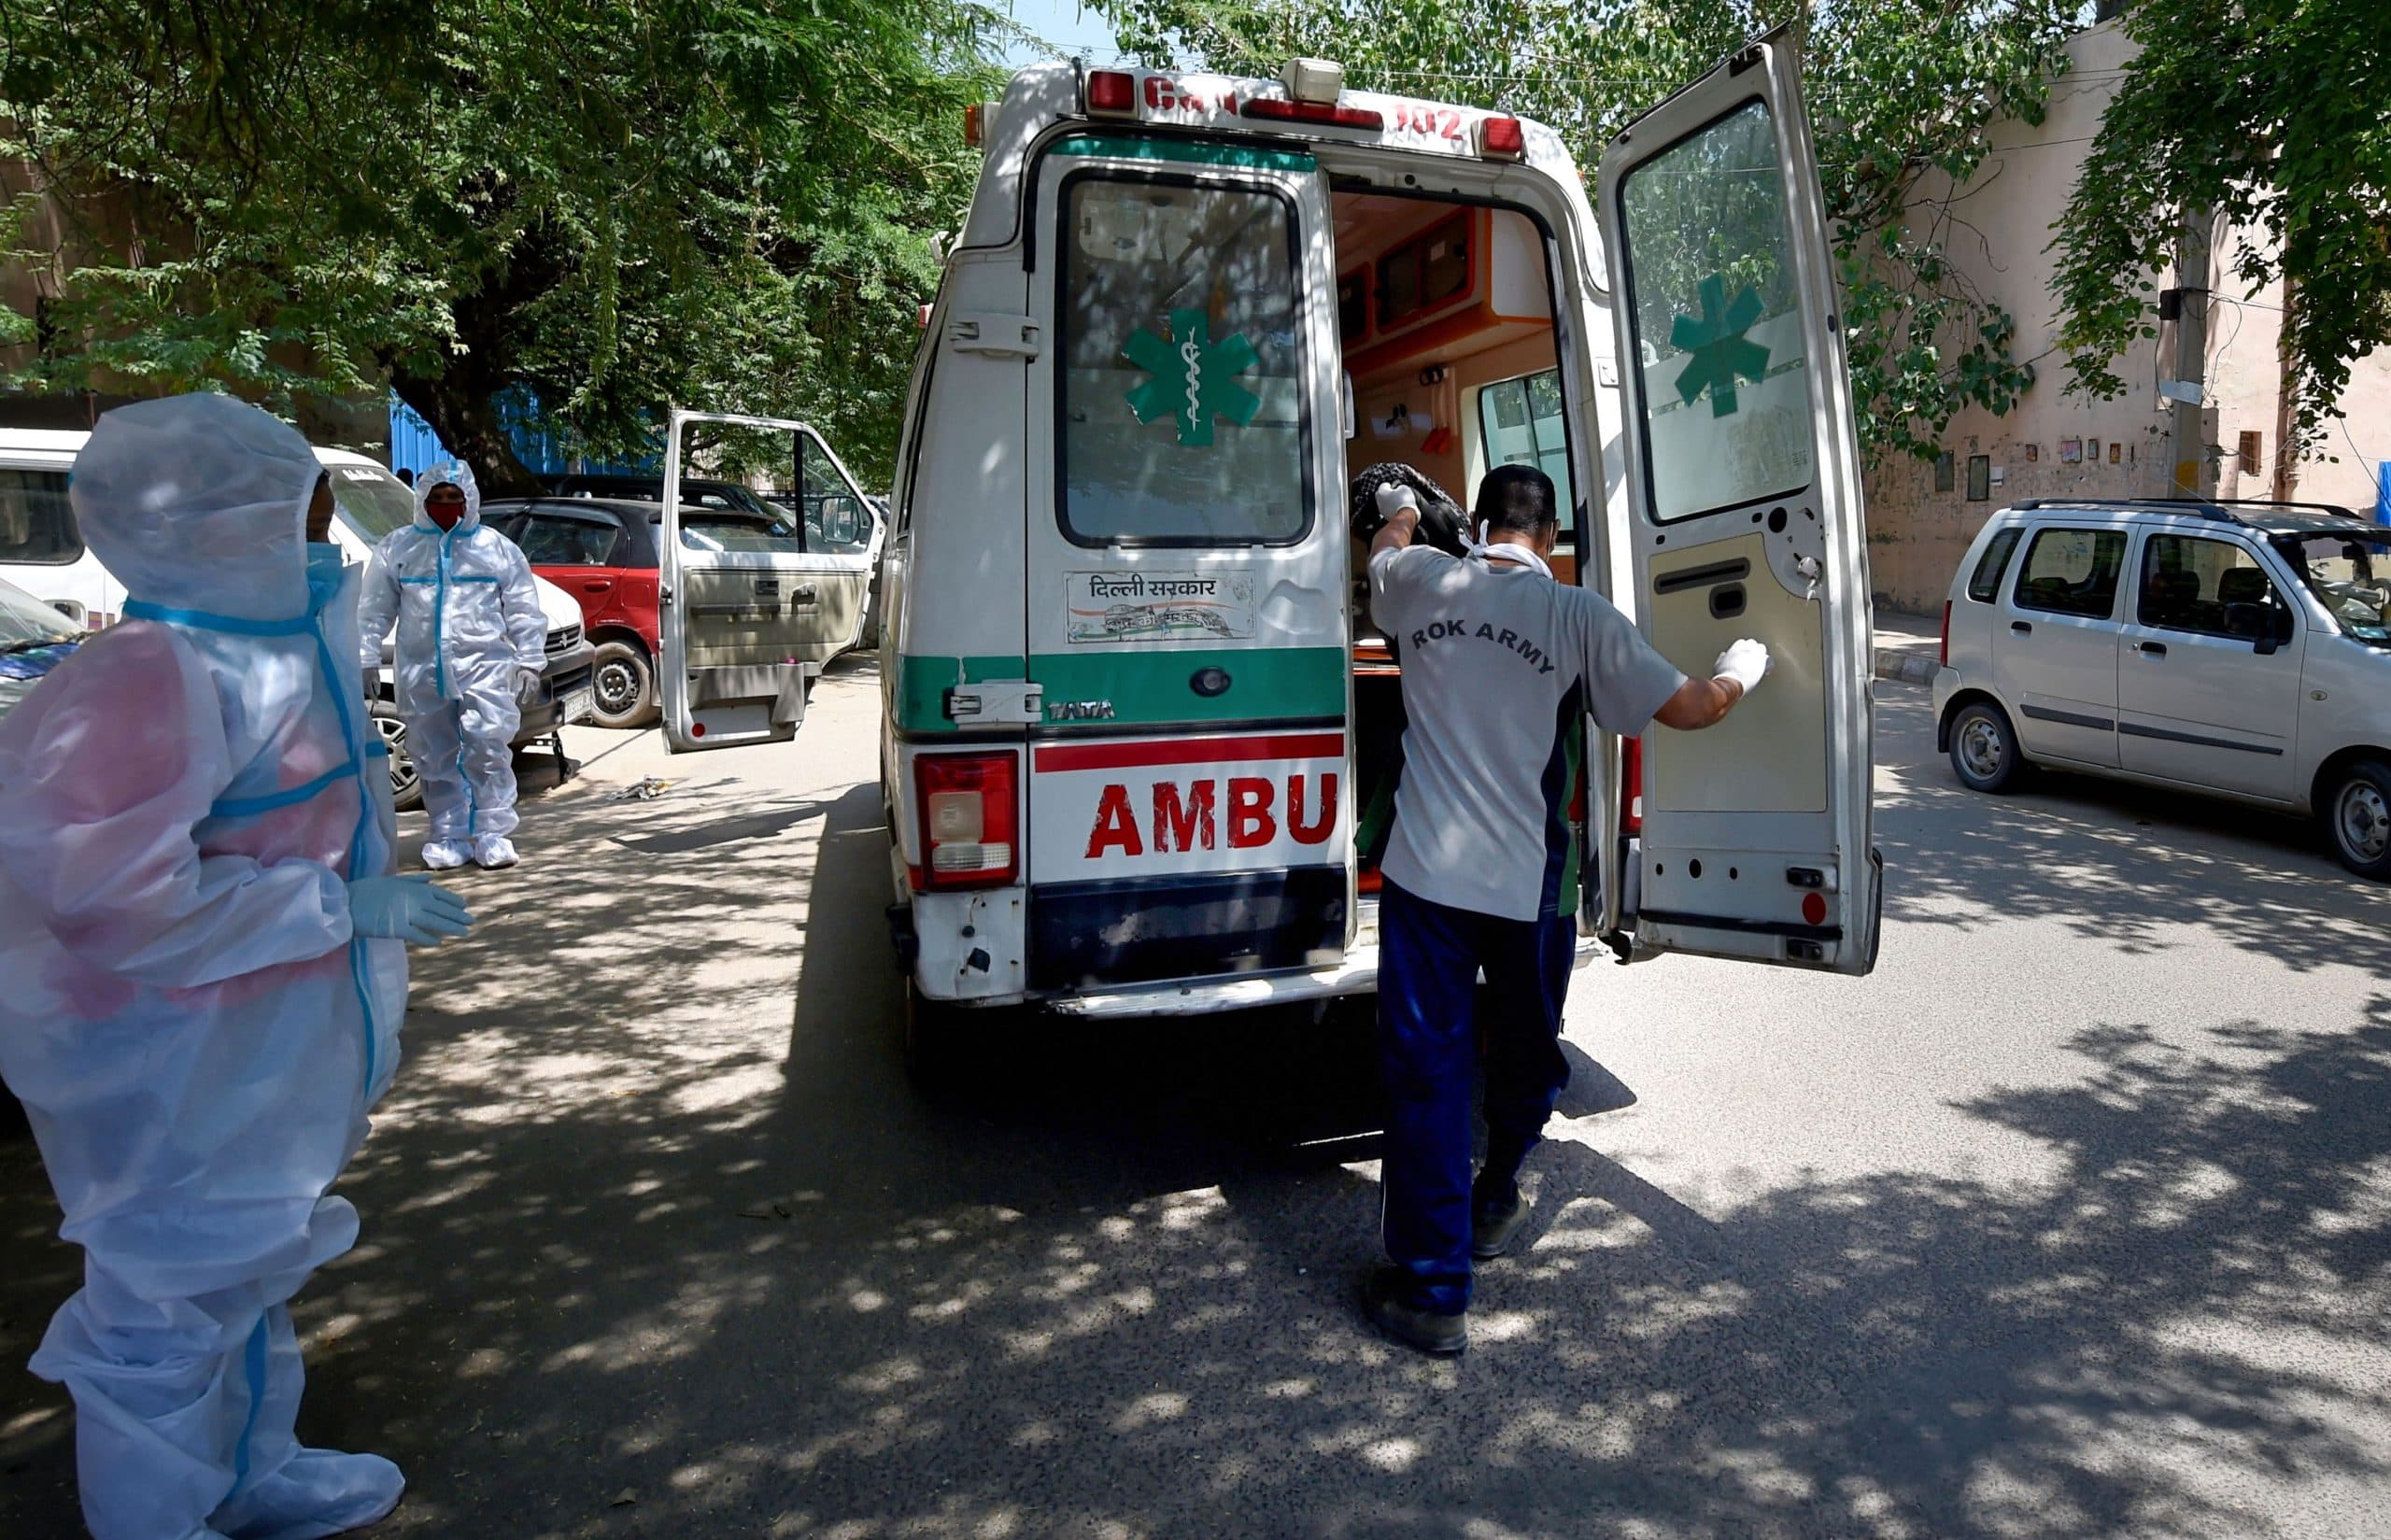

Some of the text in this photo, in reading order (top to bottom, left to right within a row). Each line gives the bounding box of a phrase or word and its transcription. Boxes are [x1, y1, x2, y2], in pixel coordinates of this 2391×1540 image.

[1394, 104, 1464, 141] 102
[1089, 574, 1216, 598] दिल्ली सरकार
[1411, 619, 1555, 675] ROK ARMY
[1048, 699, 1115, 720] TATA
[1083, 772, 1337, 858] AMBU
